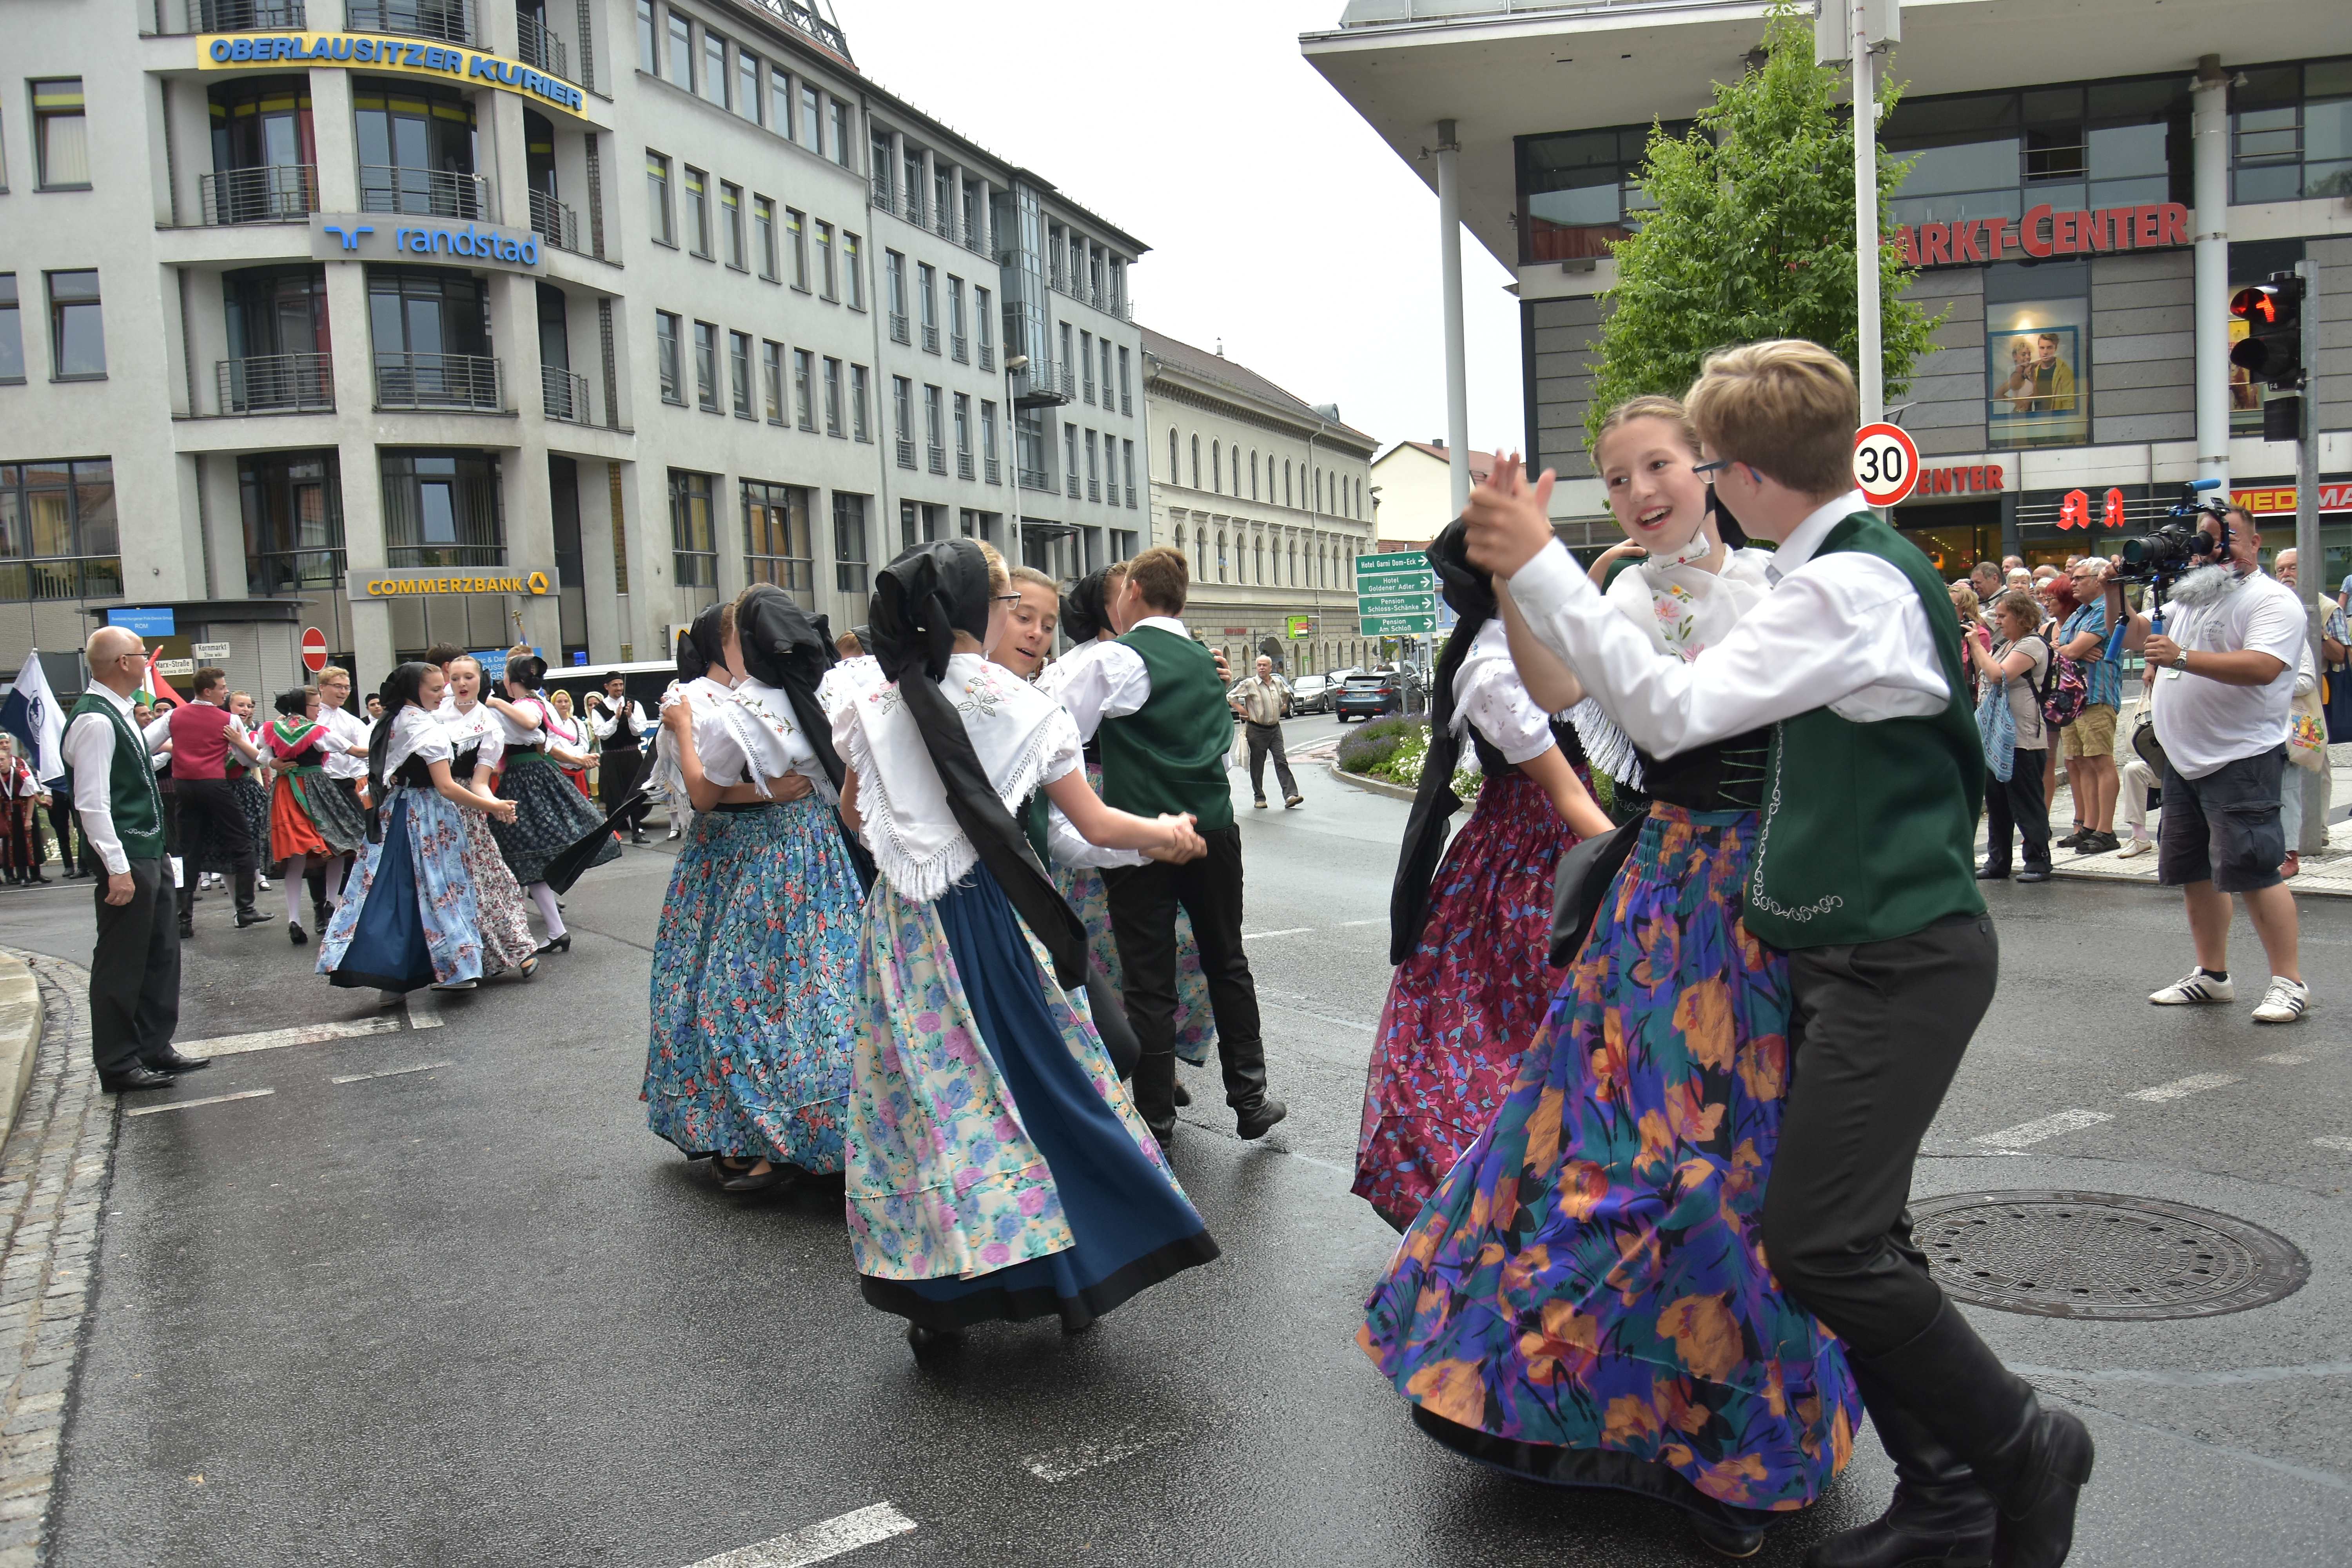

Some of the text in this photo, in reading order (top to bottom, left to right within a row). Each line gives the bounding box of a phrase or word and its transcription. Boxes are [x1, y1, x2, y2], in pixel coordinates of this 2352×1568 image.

[209, 37, 583, 111] OBERLAUSITZER KURIER
[396, 225, 538, 265] randstad
[1878, 203, 2189, 265] ARKT-CENTER
[1859, 446, 1902, 483] 30
[1912, 465, 2004, 494] ENTER
[367, 577, 523, 595] COMMERZBANK
[155, 660, 189, 668] Marx-Straße
